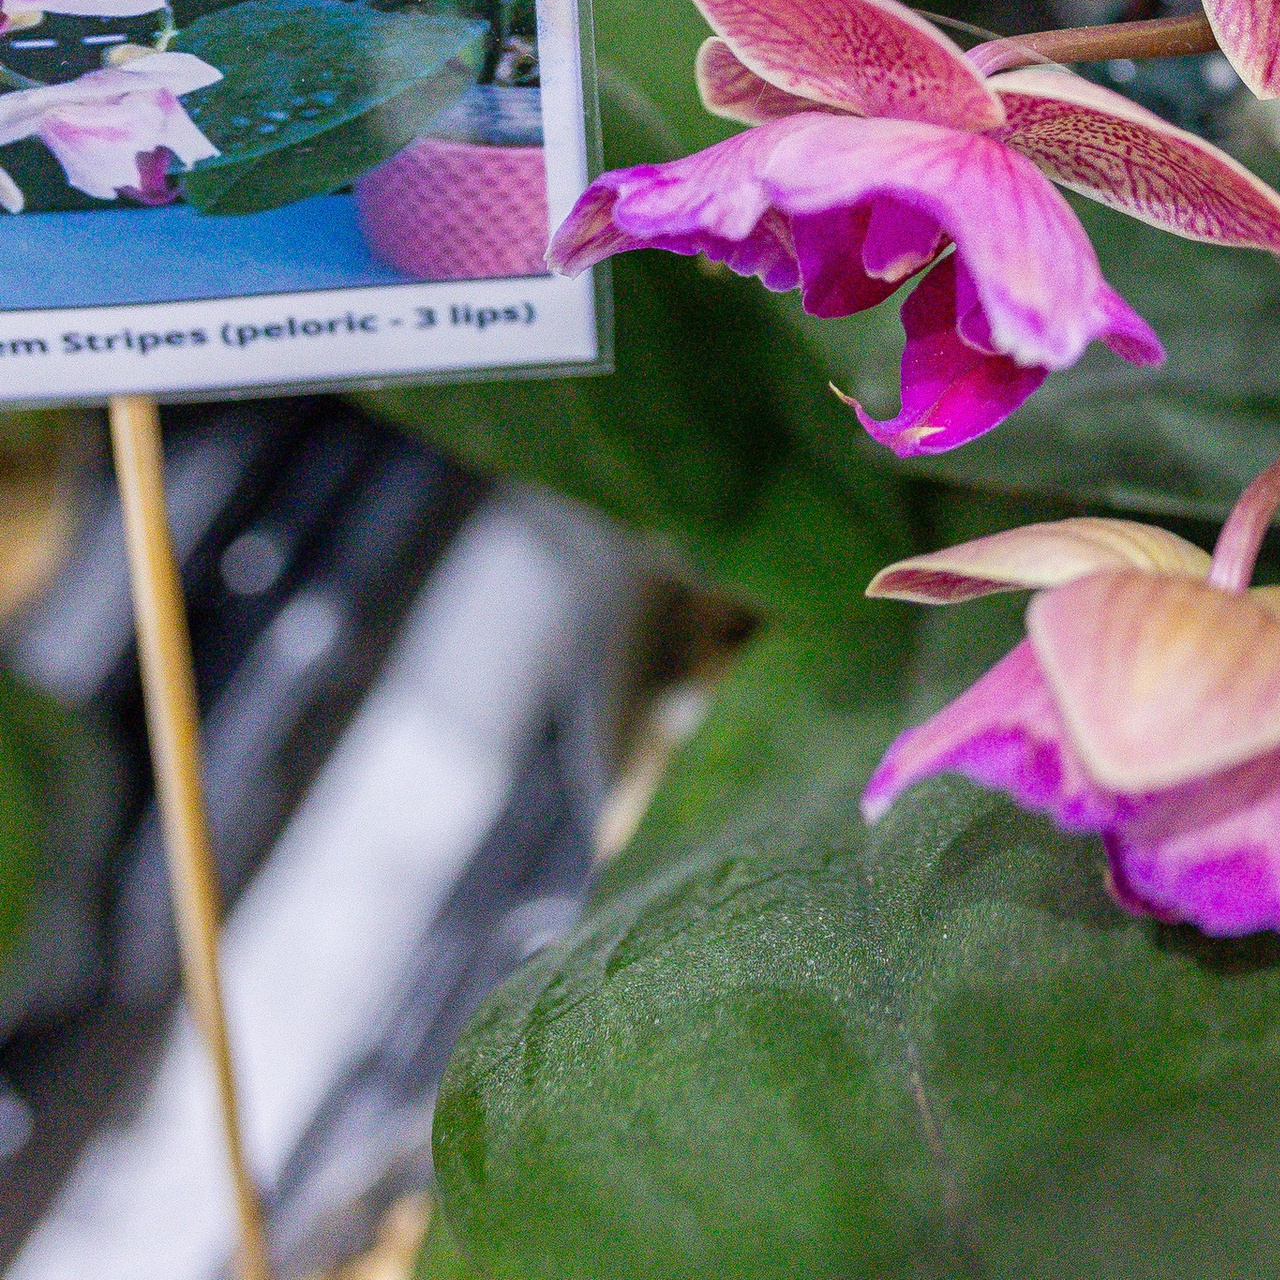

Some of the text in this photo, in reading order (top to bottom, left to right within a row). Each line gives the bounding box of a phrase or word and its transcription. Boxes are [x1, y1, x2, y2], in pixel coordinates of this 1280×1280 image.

[62, 328, 208, 355] Stripes
[220, 312, 378, 347] (peloric
[416, 307, 436, 329] 3
[450, 301, 536, 331] lips)
